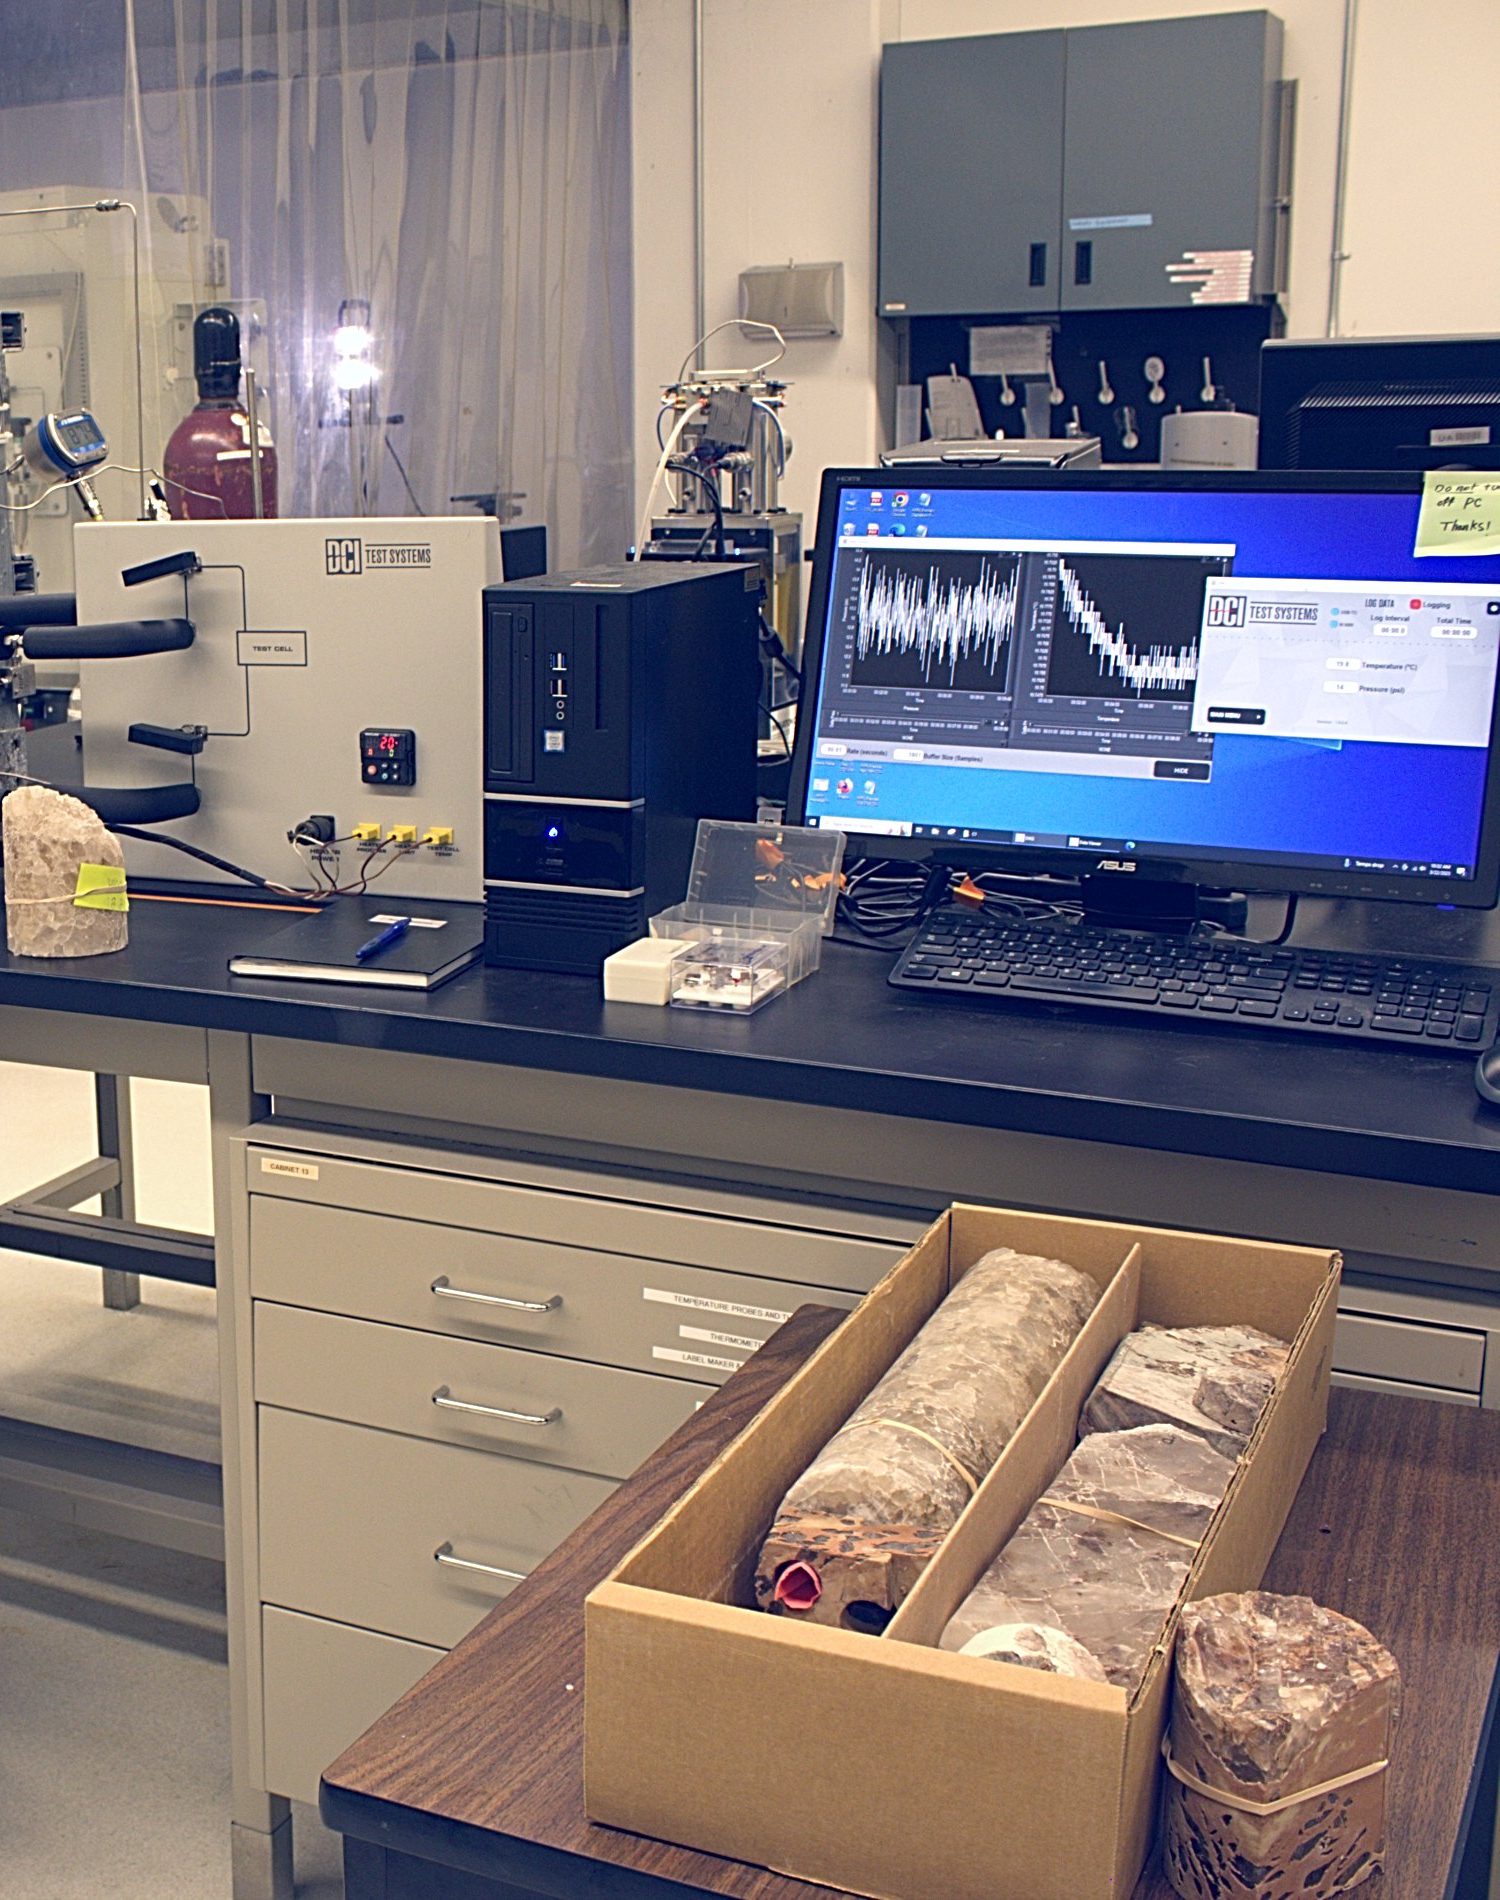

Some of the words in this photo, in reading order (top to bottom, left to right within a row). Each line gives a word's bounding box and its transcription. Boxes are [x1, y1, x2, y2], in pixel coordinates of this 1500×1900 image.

[1435, 484, 1452, 493] Do
[1456, 483, 1478, 493] not
[1437, 496, 1455, 507] off
[1463, 497, 1482, 510] PC
[1440, 520, 1491, 536] Thanks!
[326, 539, 362, 574] DCI
[365, 548, 388, 564] TEST
[389, 548, 431, 564] SYSTEMS
[1365, 599, 1377, 608] LOG
[1379, 599, 1395, 608] DATA
[1423, 602, 1451, 610] Logging
[1208, 596, 1246, 627] DCI
[1250, 606, 1272, 619] TEST
[1274, 606, 1318, 621] SYSTEMS
[1362, 662, 1403, 671] Temperature
[1359, 685, 1388, 693] Pressure
[1390, 686, 1405, 694] (psi)
[860, 749, 888, 757] (seconds)
[954, 755, 983, 763] (Samples)
[1097, 860, 1136, 872] ASUS
[270, 1163, 300, 1173] CABINET
[674, 1295, 730, 1311] TEMPERATURE
[731, 1305, 763, 1317] PROBES
[765, 1311, 781, 1319] AND
[682, 1353, 706, 1364] LABEL
[707, 1357, 735, 1368] MAKER
